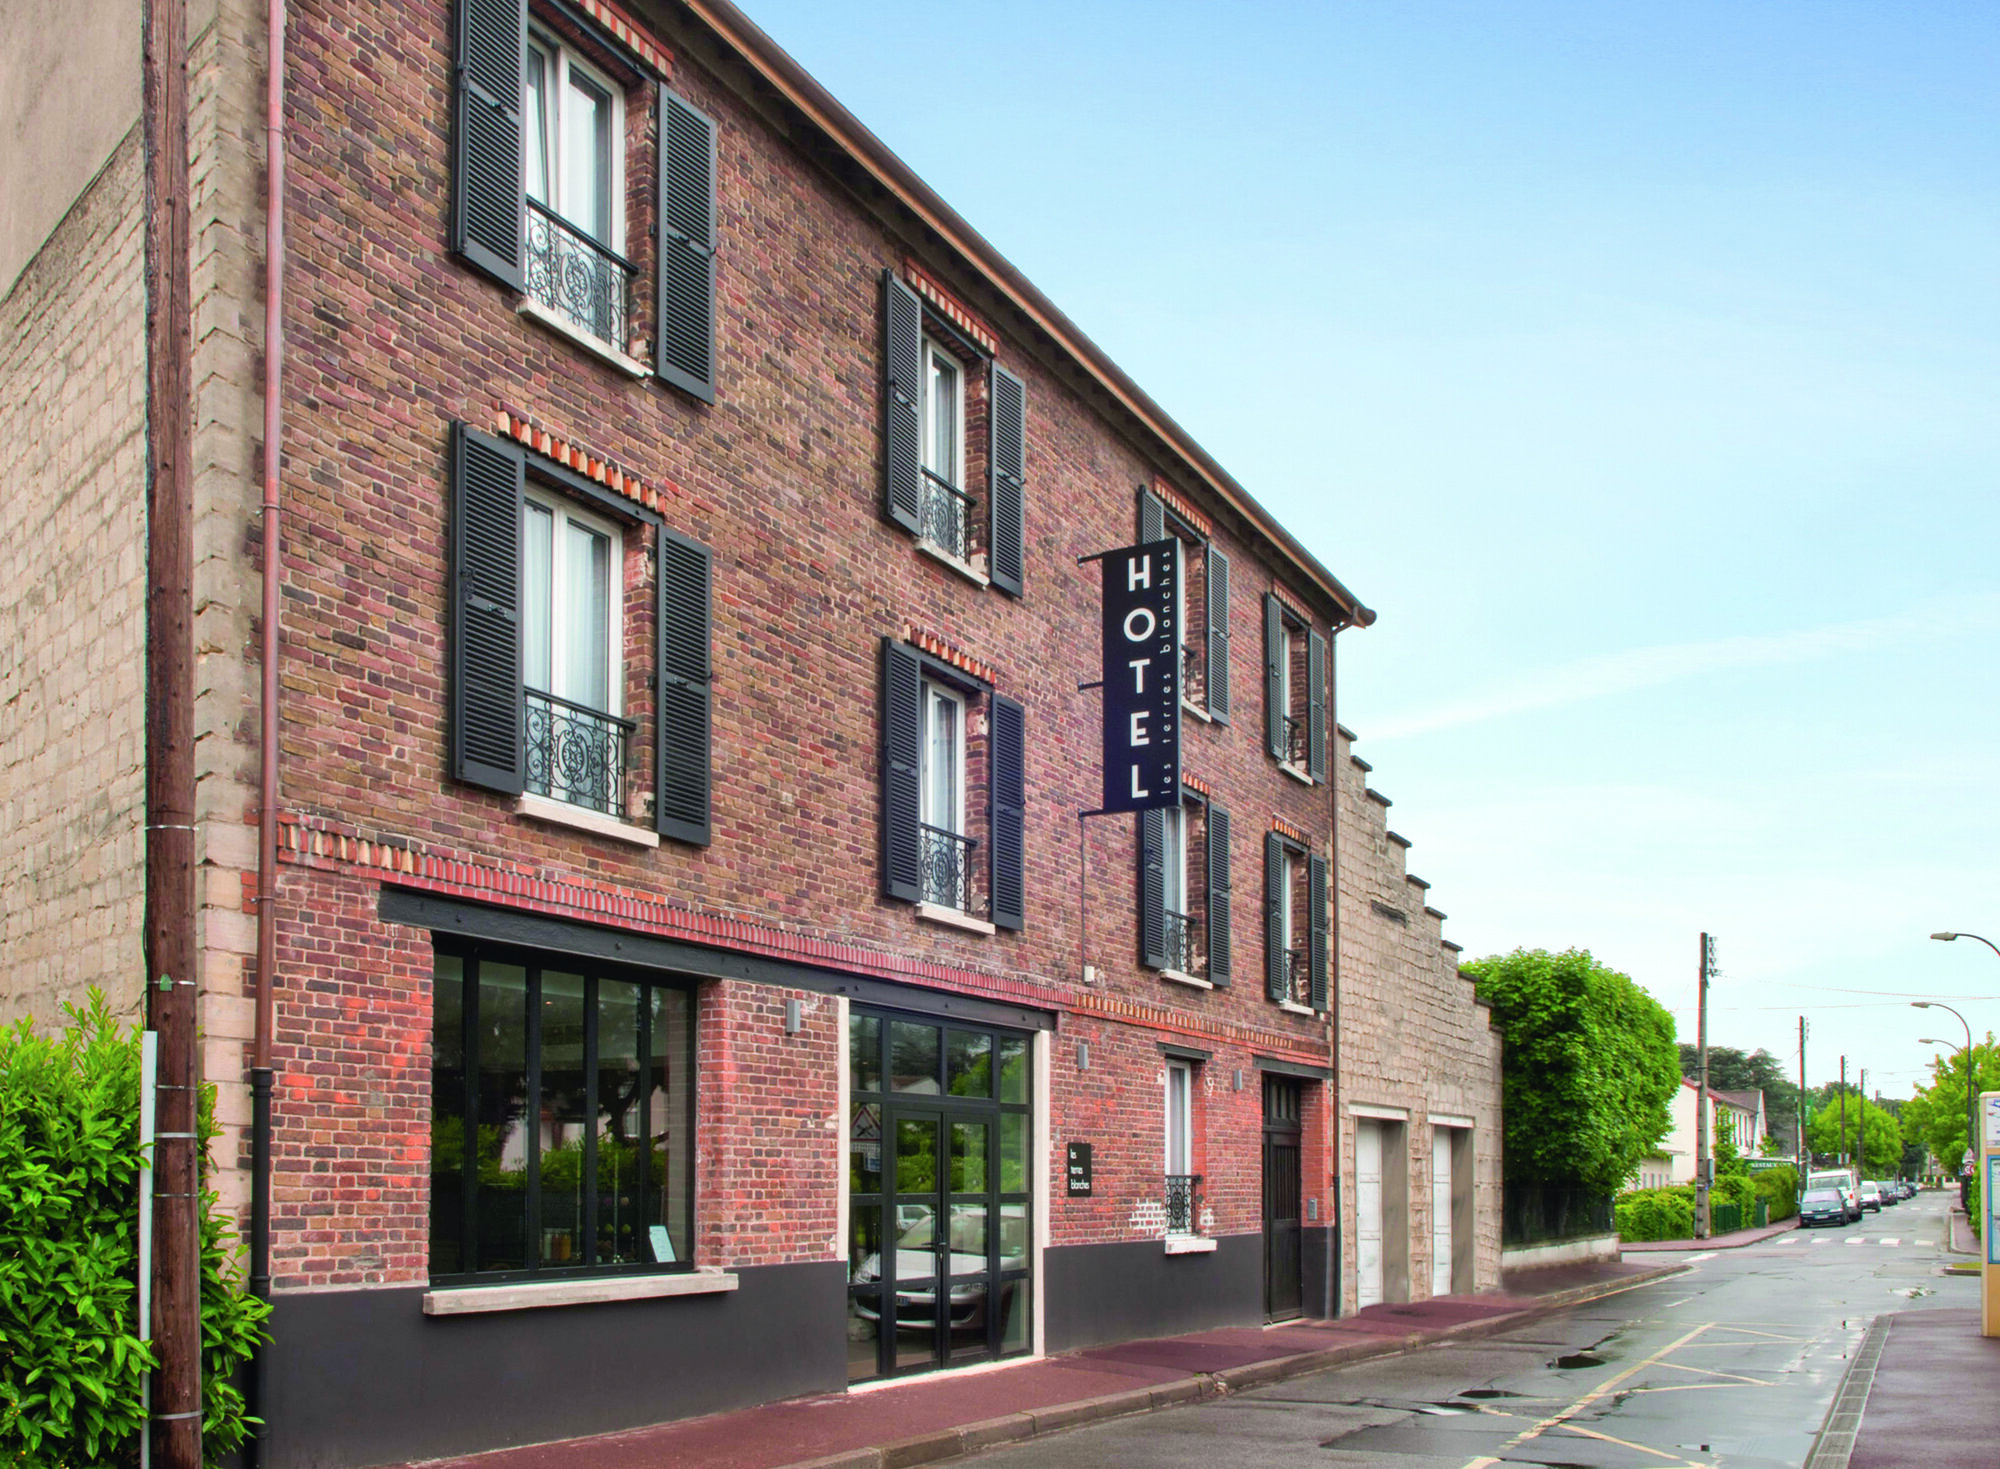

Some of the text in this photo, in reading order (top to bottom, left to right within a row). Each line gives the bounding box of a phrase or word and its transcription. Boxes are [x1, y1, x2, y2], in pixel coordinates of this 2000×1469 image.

[1123, 553, 1156, 799] HOTEL
[1159, 551, 1171, 794] les terres blanches
